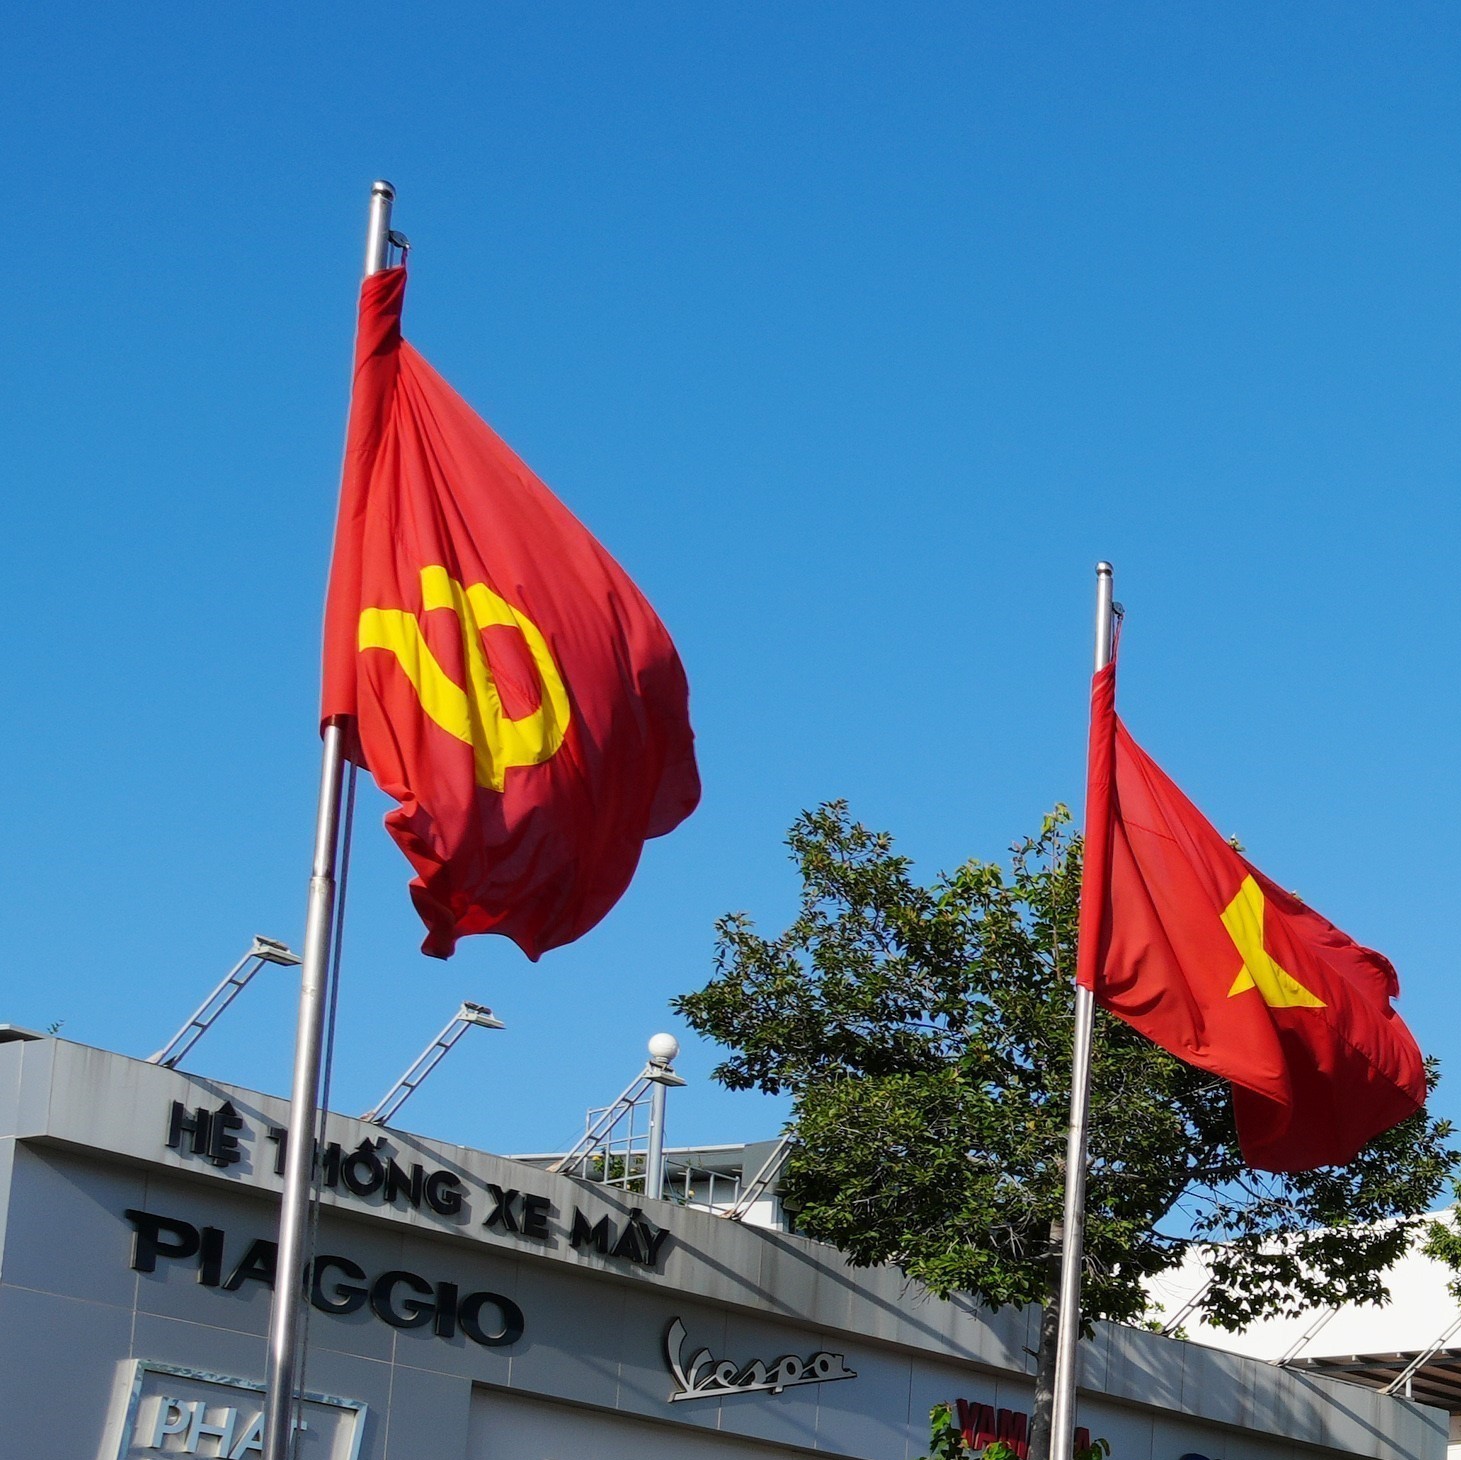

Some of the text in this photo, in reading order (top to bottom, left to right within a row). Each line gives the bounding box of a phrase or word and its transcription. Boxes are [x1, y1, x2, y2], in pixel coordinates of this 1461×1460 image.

[165, 1100, 243, 1168] HỆ
[485, 1183, 552, 1240] XE
[571, 1207, 671, 1267] MÁY
[126, 1208, 525, 1347] PIAGGIO
[663, 1316, 858, 1402] Vespa
